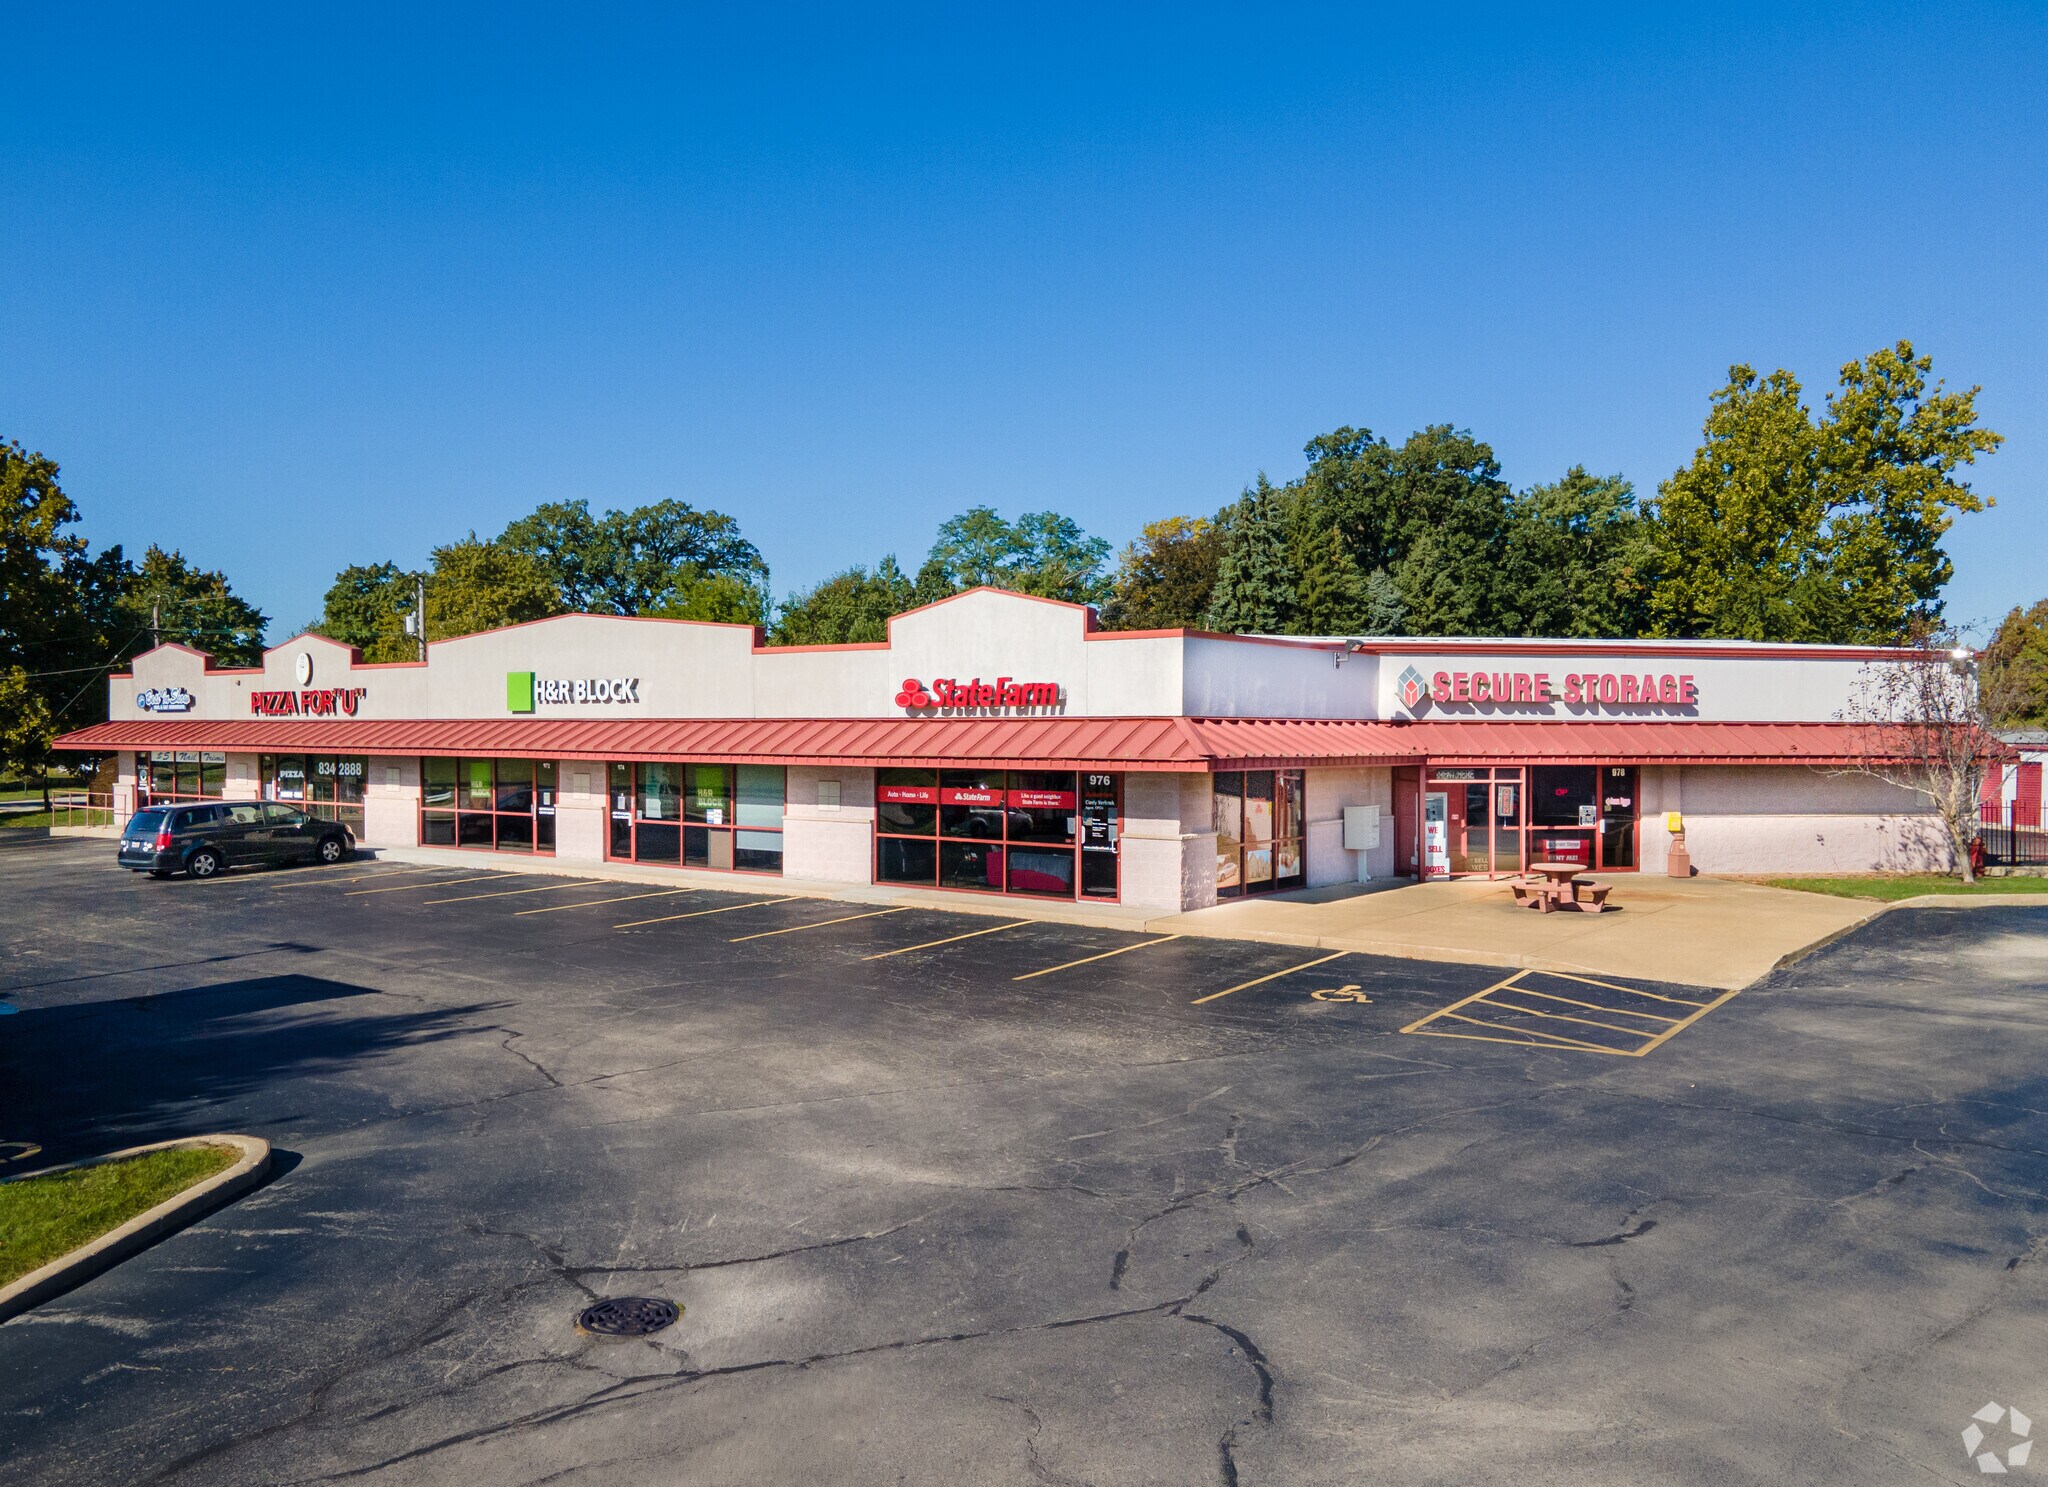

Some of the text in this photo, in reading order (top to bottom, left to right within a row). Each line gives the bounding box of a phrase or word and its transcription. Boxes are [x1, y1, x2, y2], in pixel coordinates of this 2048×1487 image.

[534, 679, 634, 701] H&R BLOCK
[1433, 671, 1694, 703] SECURE STORAGE
[251, 691, 295, 714] PIZZA
[301, 690, 333, 714] FOR
[156, 751, 225, 762] $5 Nail Trims
[280, 770, 304, 779] PIZZA
[318, 762, 362, 776] 834 2888
[1611, 768, 1626, 777] 978
[1089, 774, 1111, 786] 976
[697, 788, 714, 798] H&R
[697, 797, 723, 808] BLOCK
[1503, 789, 1511, 814] OPEN
[1428, 826, 1438, 834] WE
[1425, 865, 1446, 874] BOXES
